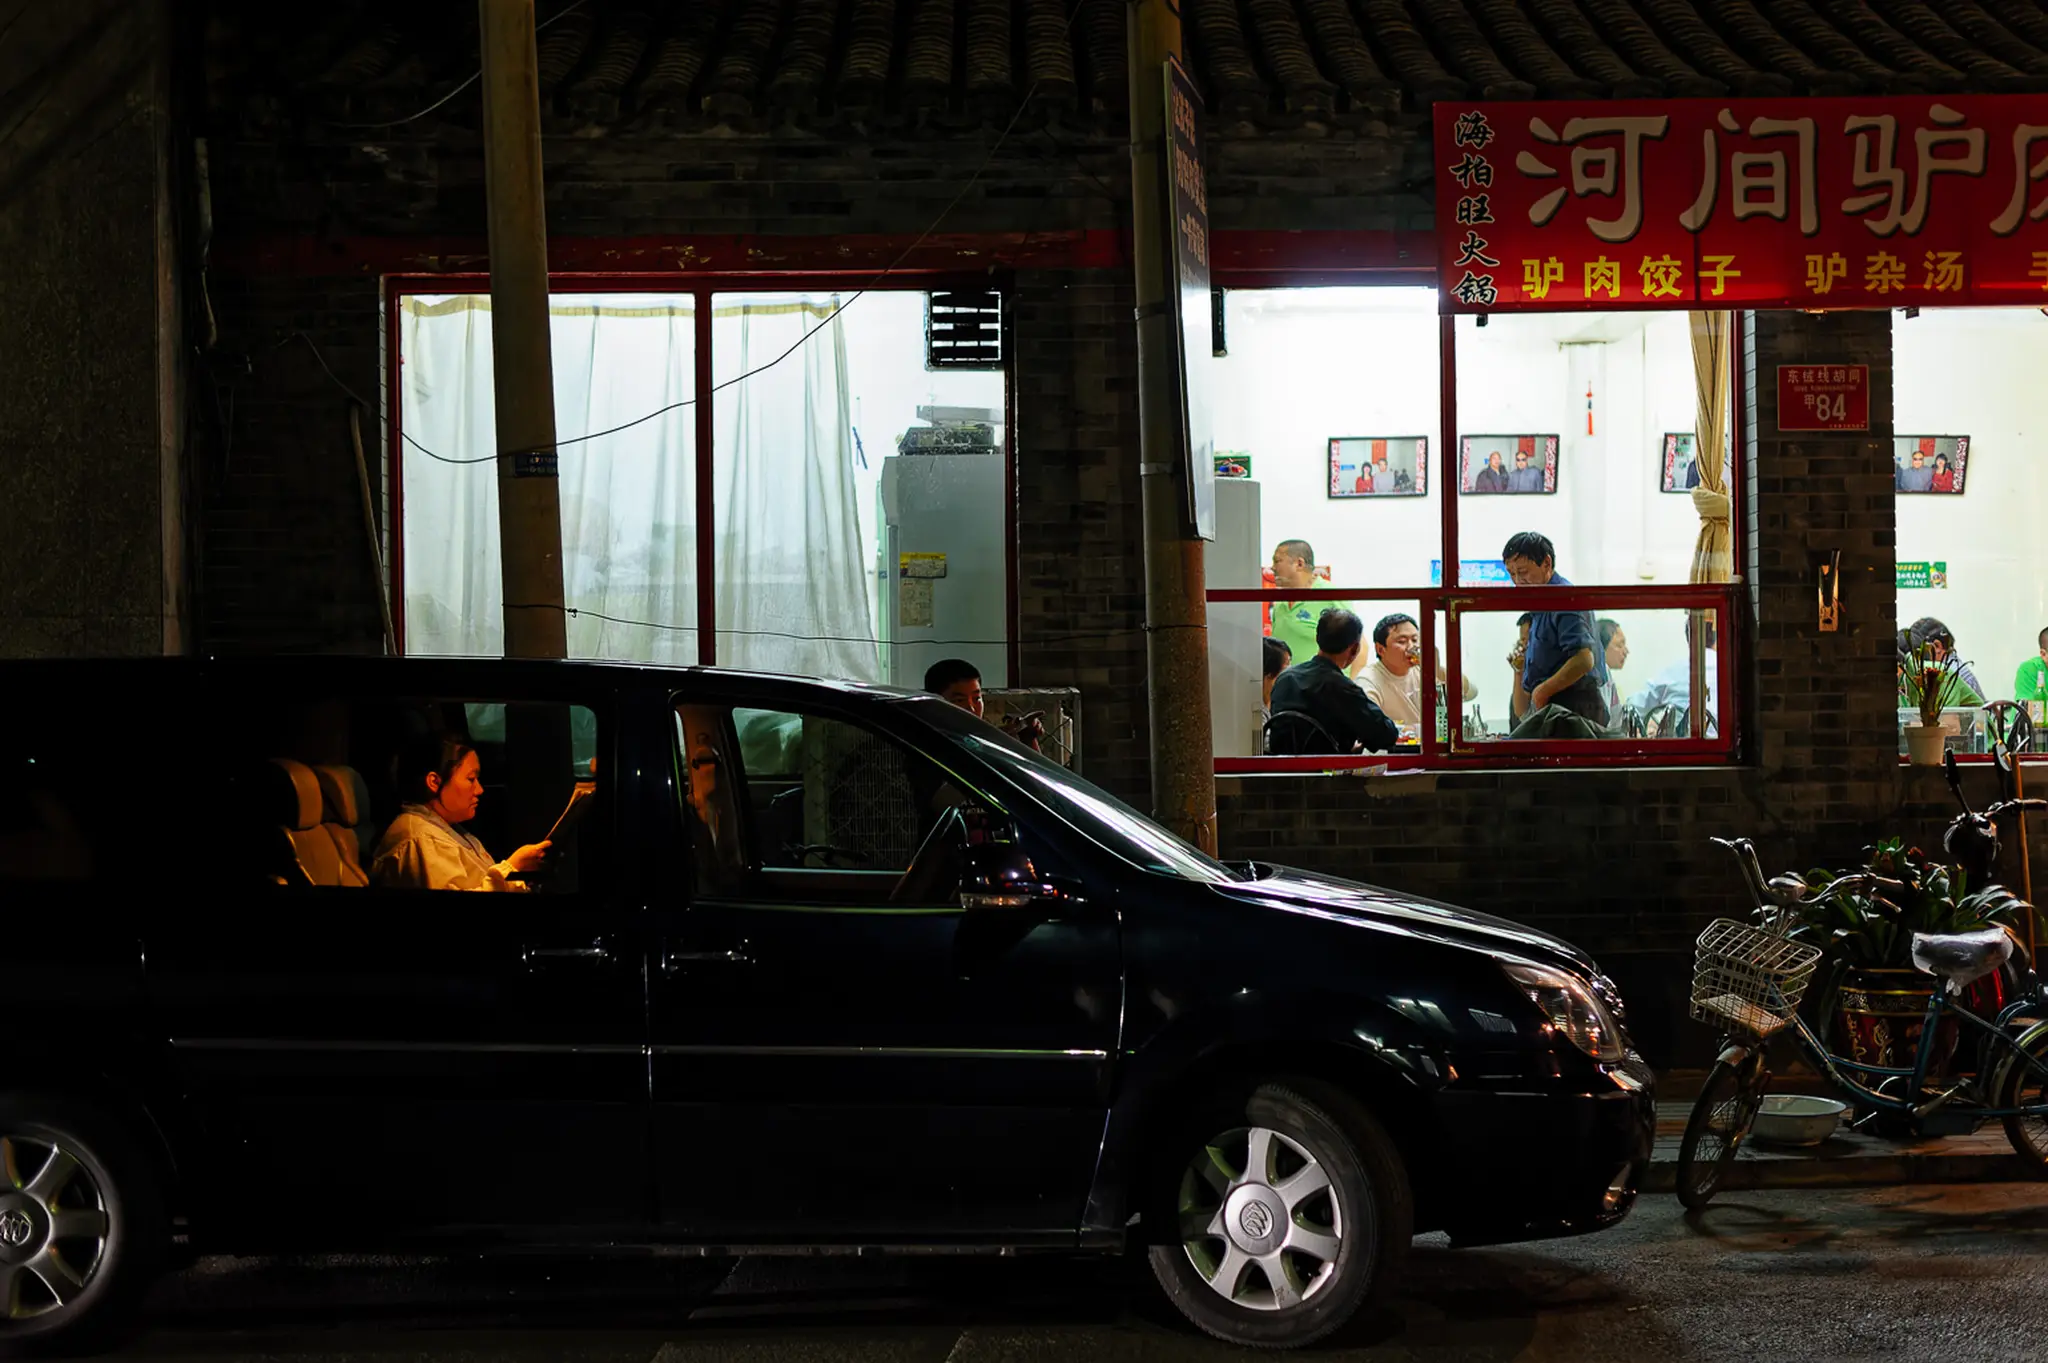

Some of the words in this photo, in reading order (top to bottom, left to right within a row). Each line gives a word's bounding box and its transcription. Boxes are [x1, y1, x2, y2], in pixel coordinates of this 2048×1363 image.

[1522, 254, 1741, 298] 驴肉饺子
[1805, 251, 1964, 293] 驴杂汤
